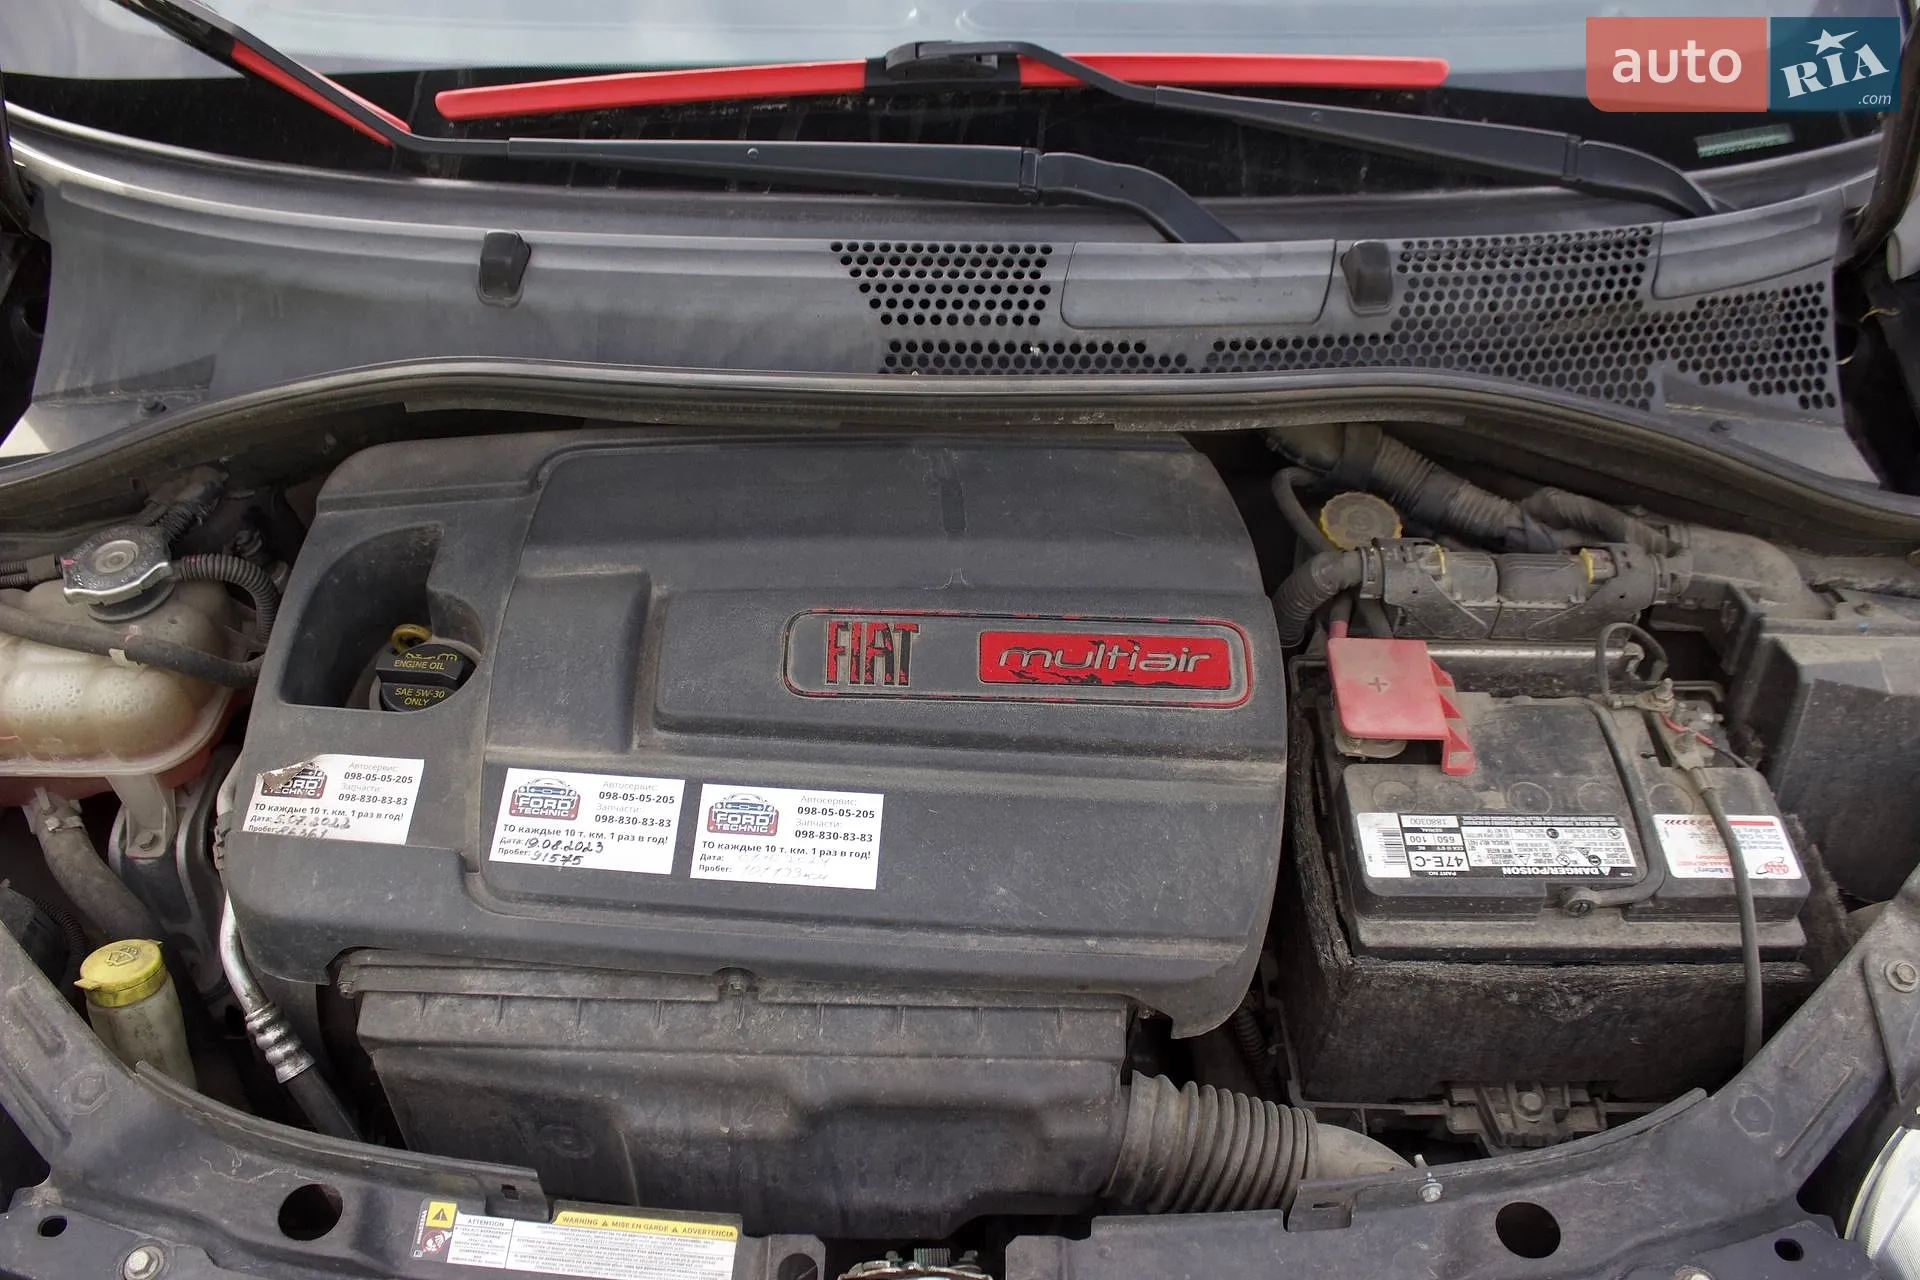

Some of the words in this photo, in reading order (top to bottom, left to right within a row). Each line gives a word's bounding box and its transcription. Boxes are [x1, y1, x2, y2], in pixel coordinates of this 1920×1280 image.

[824, 620, 921, 687] FIAT
[999, 641, 1210, 673] multiair
[394, 660, 427, 669] ENGINE
[429, 661, 445, 670] OIL
[395, 687, 413, 697] SAE
[416, 689, 445, 698] 5W-30
[404, 697, 430, 706] ONLY
[349, 761, 399, 772] Автосервис:
[344, 772, 413, 784] 098-05-05-205
[603, 781, 659, 792] Автосервис:
[338, 793, 408, 806] 098-830-83-83
[599, 791, 675, 804] 098-05-05-205
[800, 795, 858, 806] Автосервис:
[518, 797, 571, 810] FORD
[255, 803, 266, 811] ТО
[268, 804, 307, 815] каждые
[310, 806, 319, 815] 10
[332, 809, 347, 817] км.
[357, 811, 374, 820] раз
[384, 812, 404, 821] год!
[517, 806, 569, 817] TECHNIC
[797, 806, 875, 819] 098-05-05-205
[250, 814, 273, 823] Дата:
[595, 814, 671, 828] 098-830-83-83
[717, 813, 770, 826] FORD
[248, 825, 277, 833] Пробег:
[716, 823, 769, 833] TECHNIC
[503, 824, 516, 832] ТО
[518, 826, 561, 837] каждые
[565, 829, 575, 837] 10
[589, 831, 606, 839] км.
[617, 834, 635, 842] раз
[647, 834, 668, 845] год!
[795, 829, 873, 842] 098-830-83-83
[499, 836, 524, 846] Дата:
[524, 837, 604, 853] 19.08.2023
[498, 847, 530, 857] Пробег:
[702, 841, 715, 849] ТО
[718, 842, 762, 852] каждые
[766, 845, 776, 853] 10
[790, 847, 808, 856] км.
[819, 850, 837, 858] раз
[849, 850, 871, 860] год!
[699, 853, 724, 862] Дата:
[1414, 855, 1464, 867] 47E-C
[699, 864, 732, 873] Пробег:
[1502, 867, 1599, 876] DANGER/POISON
[467, 1219, 505, 1227] ATTENTION
[562, 1216, 598, 1226] WARNING
[612, 1220, 630, 1228] MISE
[644, 1222, 669, 1232] GARDE
[682, 1226, 734, 1238] ADVERTENCIA
